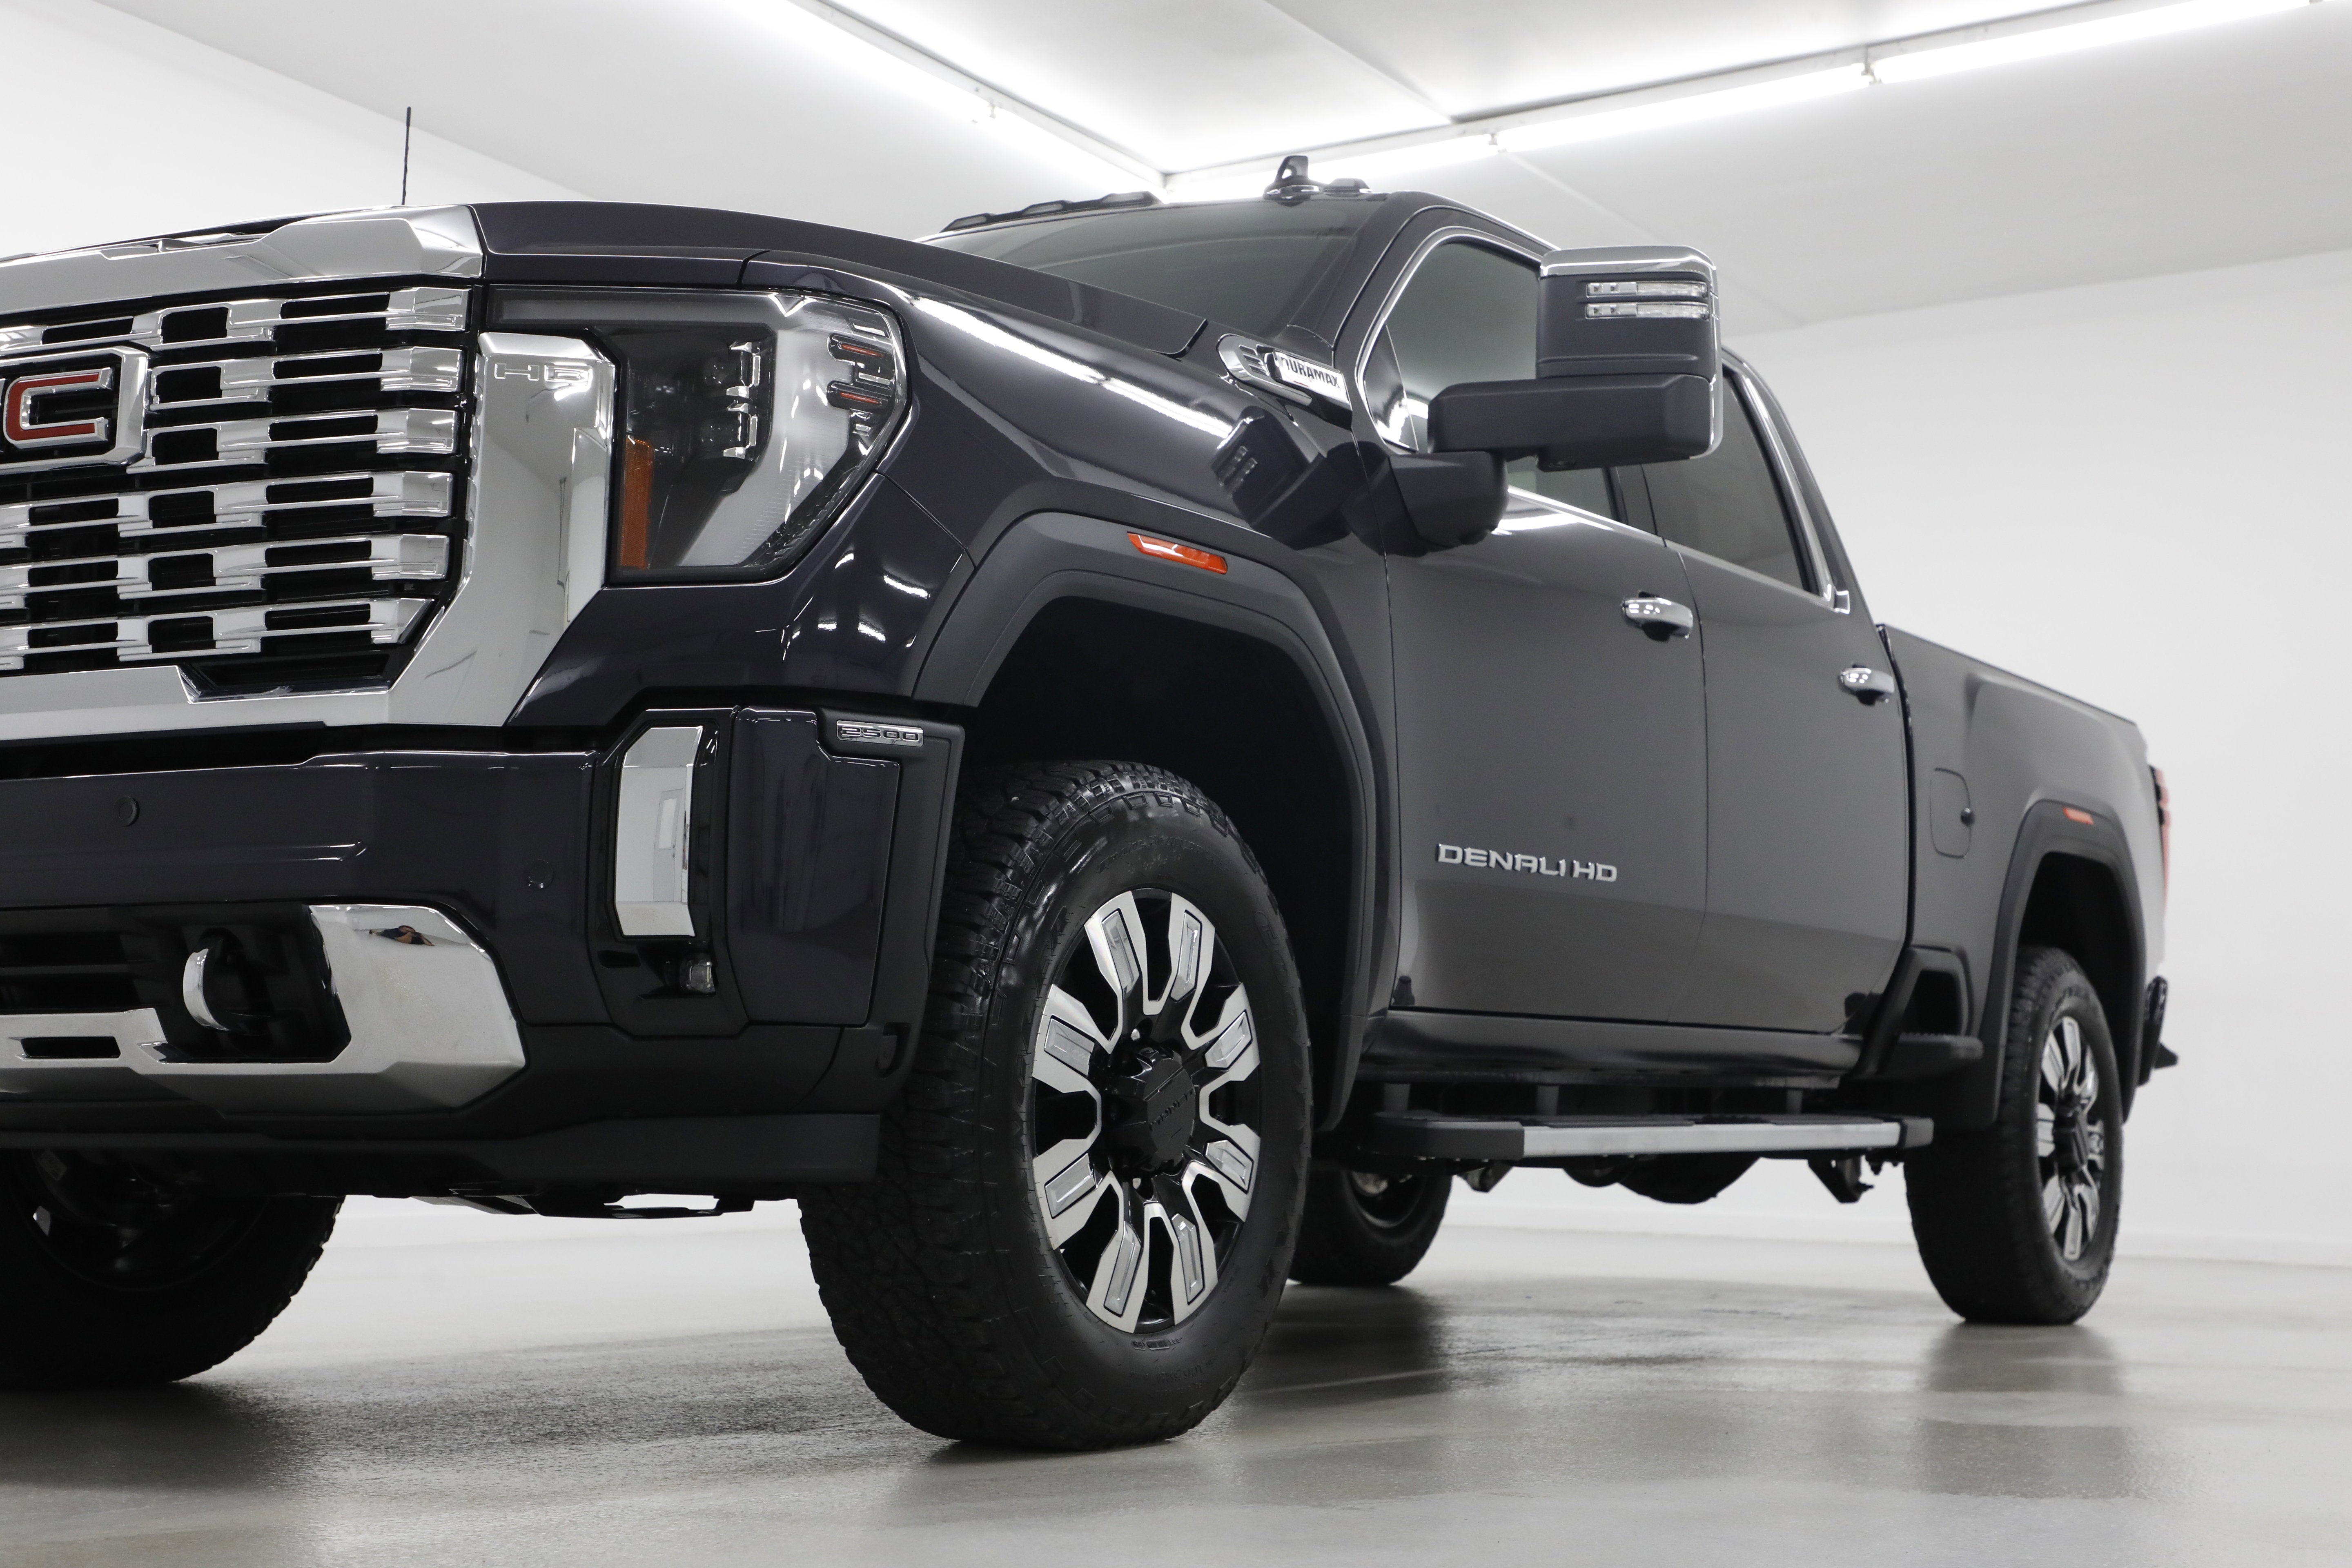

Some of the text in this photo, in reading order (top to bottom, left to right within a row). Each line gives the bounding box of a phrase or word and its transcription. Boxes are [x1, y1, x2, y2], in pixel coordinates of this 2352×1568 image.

[841, 726, 919, 742] 2500
[1437, 843, 1617, 882] DENALI HD
